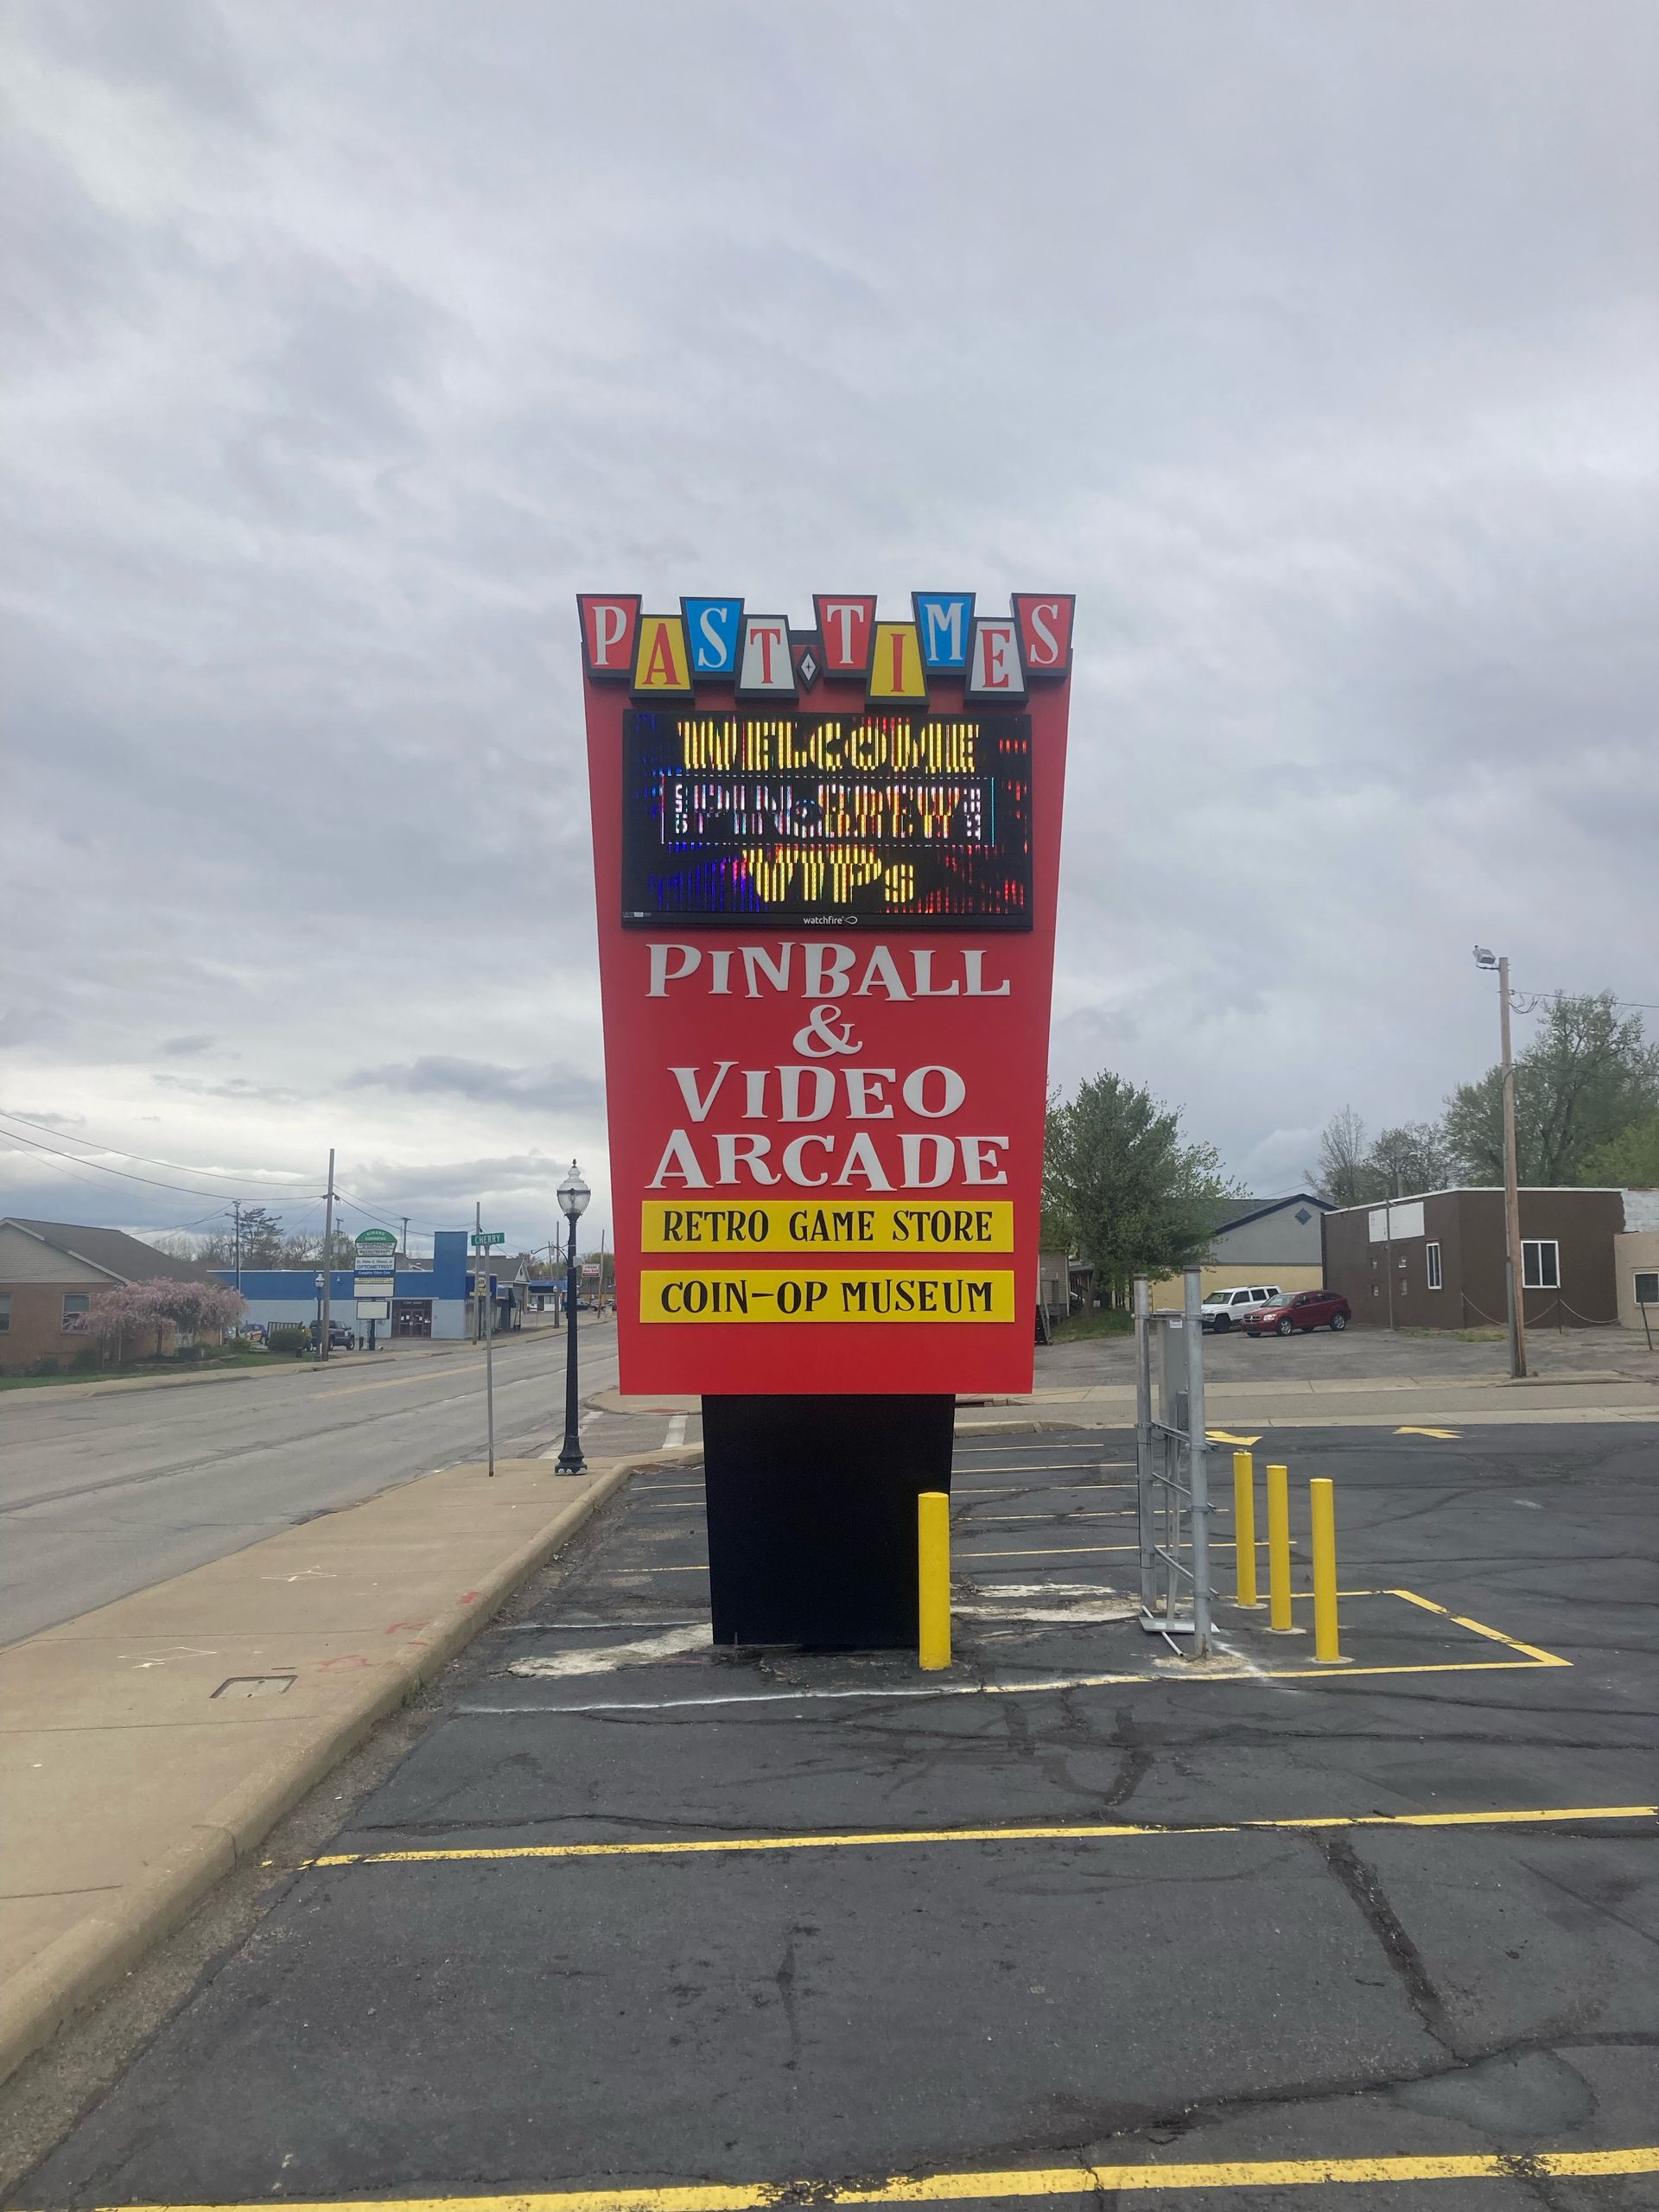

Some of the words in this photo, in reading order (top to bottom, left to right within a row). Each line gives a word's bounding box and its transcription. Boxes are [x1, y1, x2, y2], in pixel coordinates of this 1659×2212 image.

[592, 605, 781, 685] PAST
[826, 602, 1060, 693] TIMES
[677, 721, 980, 773] WELCOME
[741, 846, 914, 905] VIPs
[803, 915, 843, 925] watchfire
[645, 942, 1011, 1001] PINBALL
[792, 1004, 863, 1058] &
[667, 1061, 967, 1123] VIDEO
[644, 1128, 1010, 1192] ARCADE
[475, 1234, 500, 1245] CHERRY
[662, 1209, 770, 1243] RETRO
[788, 1210, 874, 1242] GAME
[892, 1210, 994, 1243] STORE
[660, 1280, 829, 1315] COIN-OP
[842, 1279, 994, 1313] MUSEUM
